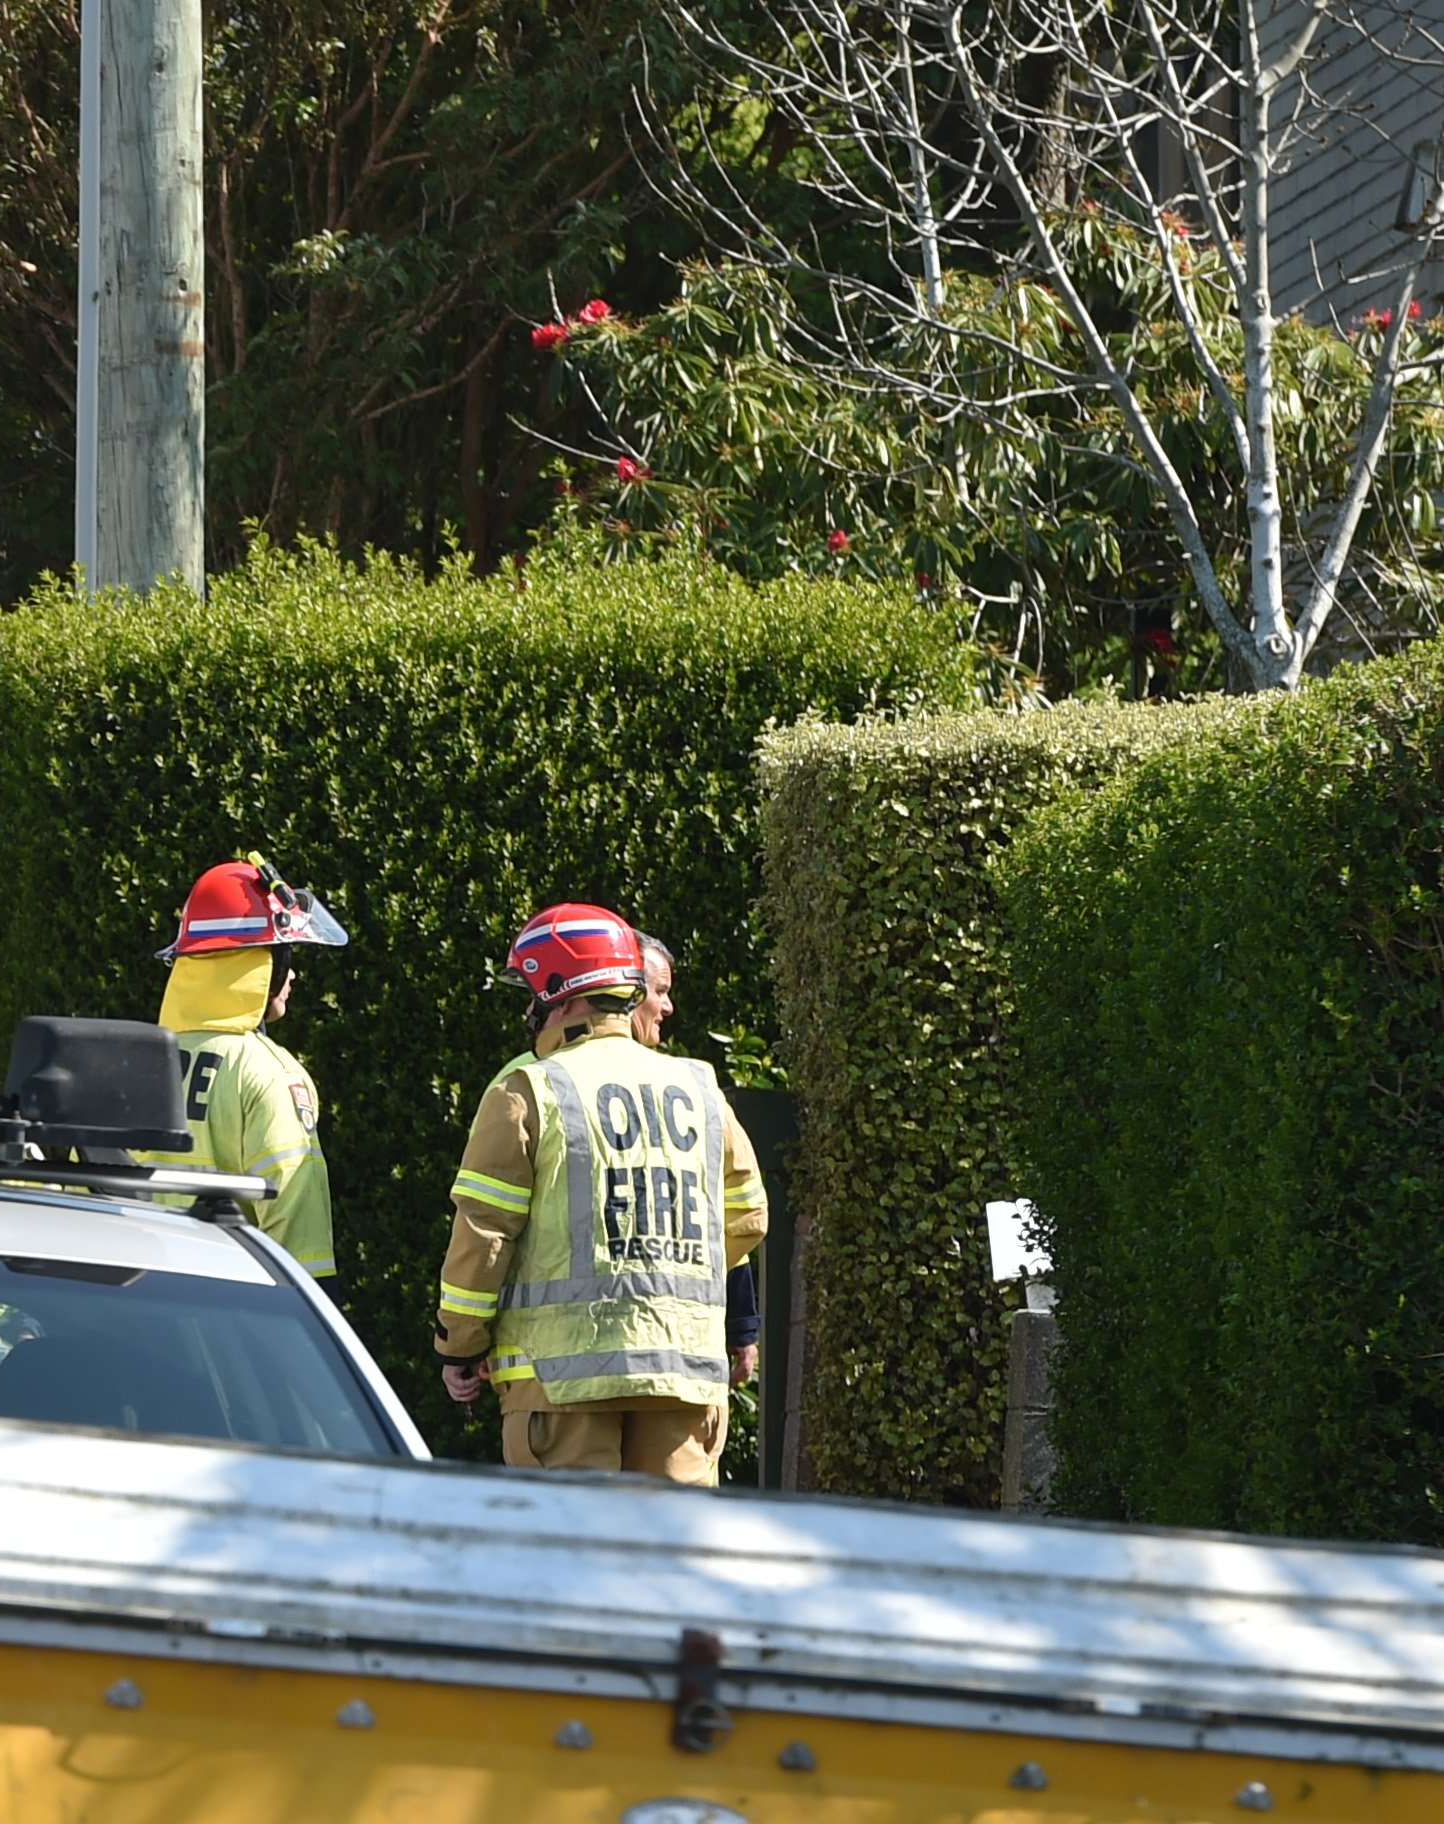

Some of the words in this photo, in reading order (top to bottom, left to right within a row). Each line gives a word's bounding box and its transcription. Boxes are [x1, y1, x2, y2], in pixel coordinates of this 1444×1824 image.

[596, 1083, 699, 1153] OIC
[604, 1165, 703, 1240] FIRE
[607, 1237, 705, 1266] RESCUE
